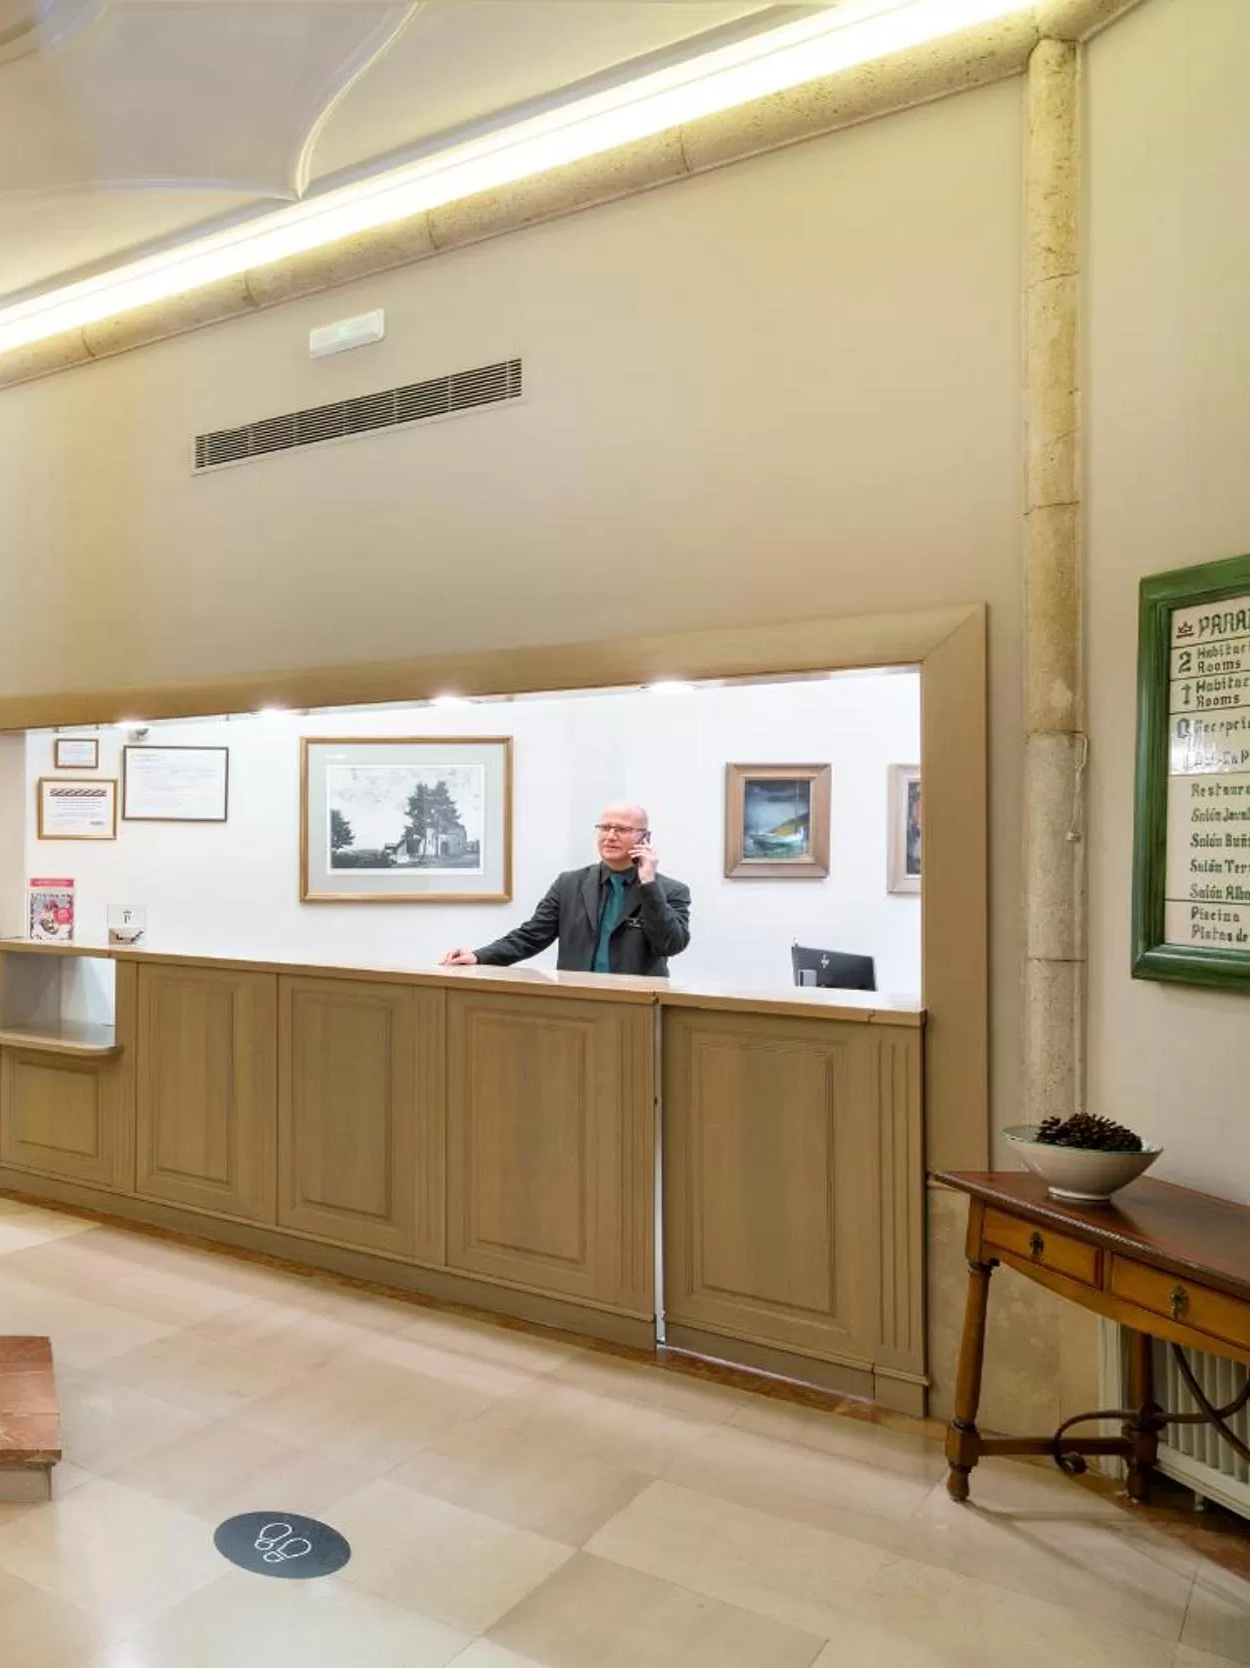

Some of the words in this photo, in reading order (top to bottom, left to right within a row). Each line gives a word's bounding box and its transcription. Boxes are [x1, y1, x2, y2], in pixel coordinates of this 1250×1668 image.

[1198, 608, 1250, 639] PARA
[1177, 650, 1192, 674] 2
[1197, 643, 1250, 660] Habitac
[1197, 660, 1241, 674] Rooms
[1196, 694, 1240, 708] Rooms
[1190, 831, 1222, 848] Salón
[1191, 906, 1241, 923] Piscina
[1191, 924, 1232, 942] Pistas
[1236, 927, 1248, 943] de
